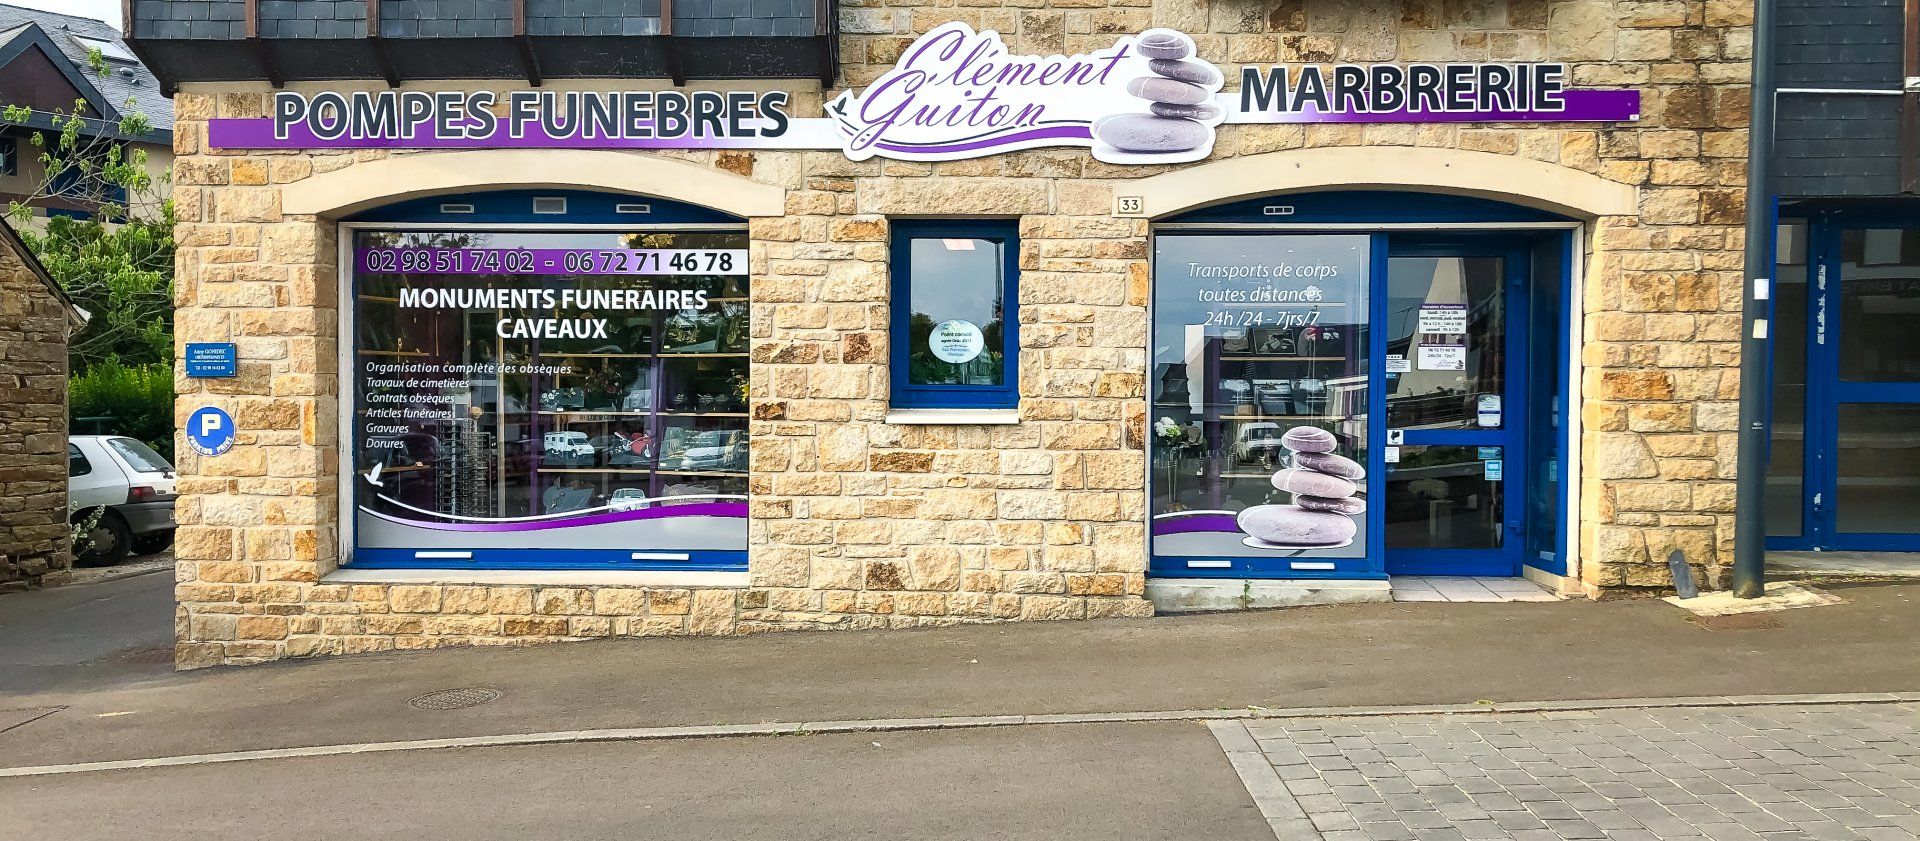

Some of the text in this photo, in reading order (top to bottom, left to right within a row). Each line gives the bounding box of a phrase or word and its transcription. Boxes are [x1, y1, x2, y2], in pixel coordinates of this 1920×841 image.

[904, 29, 1131, 87] Clément
[1239, 64, 1566, 114] MARBRERIE
[273, 90, 790, 140] POMPES FUNEBRES
[850, 70, 1050, 151] Guiton
[1121, 198, 1140, 211] 33
[366, 250, 396, 272] 02
[401, 250, 431, 272] 98
[435, 250, 463, 272] 51
[470, 250, 500, 272] 74
[504, 250, 534, 272] 02
[564, 251, 594, 272] 06
[599, 251, 629, 272] 72
[634, 251, 660, 272] 71
[669, 251, 698, 272] 46
[705, 251, 733, 272] 78
[1188, 262, 1338, 281] Transports de corps
[399, 288, 708, 311] MONUMENTS FUNERAIRES
[1198, 286, 1323, 302] toutes distances
[496, 318, 608, 339] CAVEAUX
[1204, 311, 1234, 326] 24h
[1276, 311, 1321, 330] 7jrs/7
[366, 361, 572, 376] Organisation complète des obsèques
[366, 377, 470, 389] Travaux de cimetières
[366, 392, 455, 405] Contrats obsèques
[365, 408, 452, 419] Articles funéraires
[201, 413, 221, 437] P
[366, 423, 409, 434] Gravures
[188, 435, 213, 455] PARKING
[365, 438, 404, 449] Dorures
